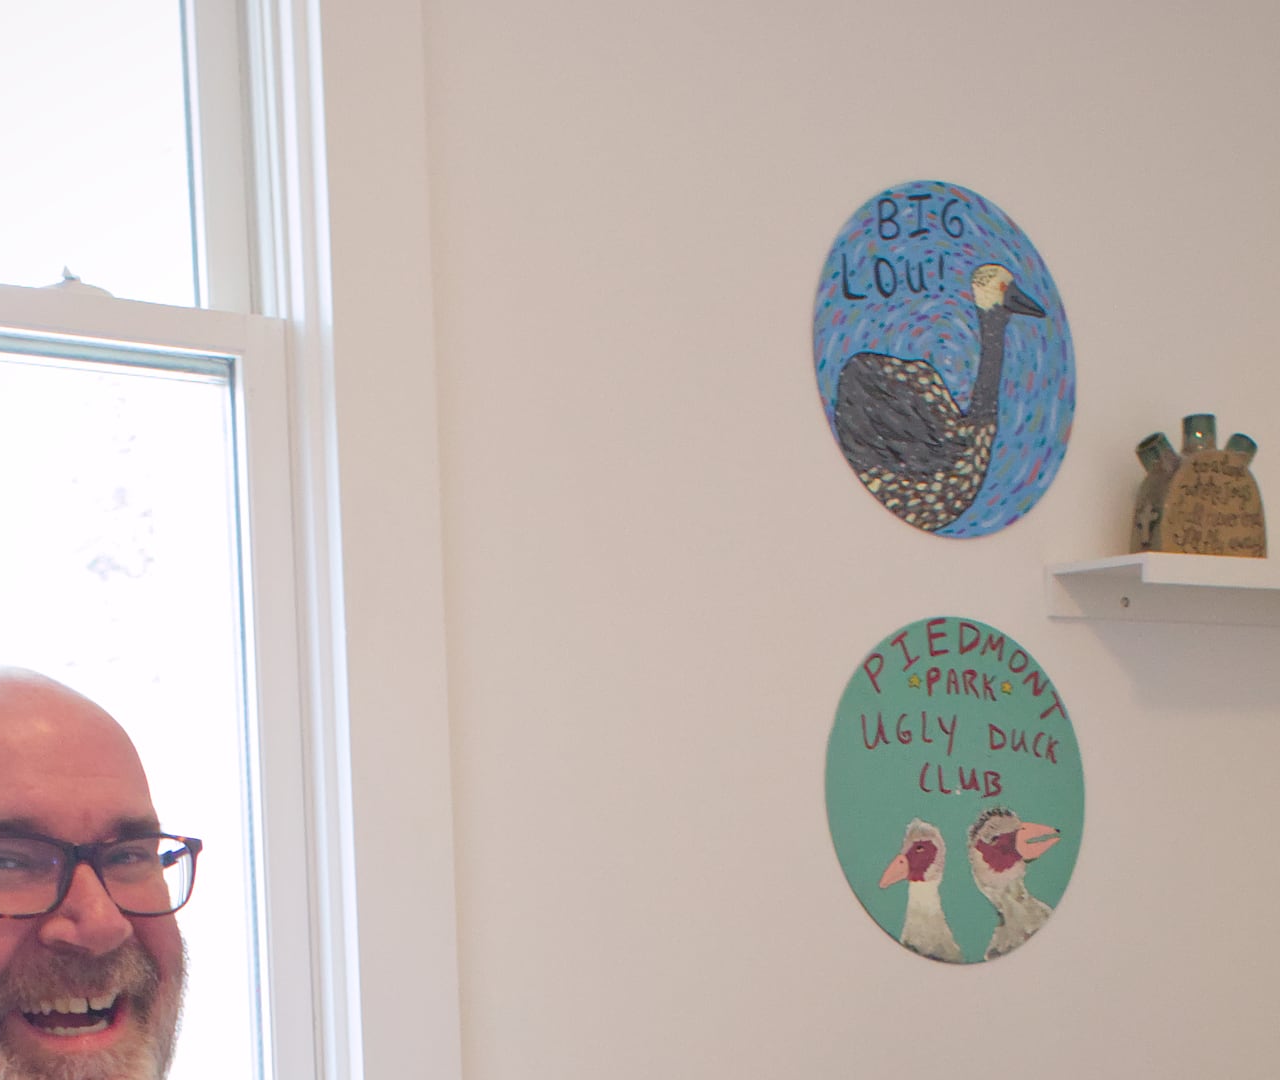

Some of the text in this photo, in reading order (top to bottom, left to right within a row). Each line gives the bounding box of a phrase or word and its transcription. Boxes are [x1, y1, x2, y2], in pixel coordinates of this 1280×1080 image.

[876, 194, 965, 241] BIG
[841, 253, 946, 301] LOU!
[863, 617, 1069, 721] PIEDMONT
[925, 666, 997, 701] PARK
[861, 711, 1060, 765] UGLY DUCK
[919, 762, 1003, 799] CLUB
